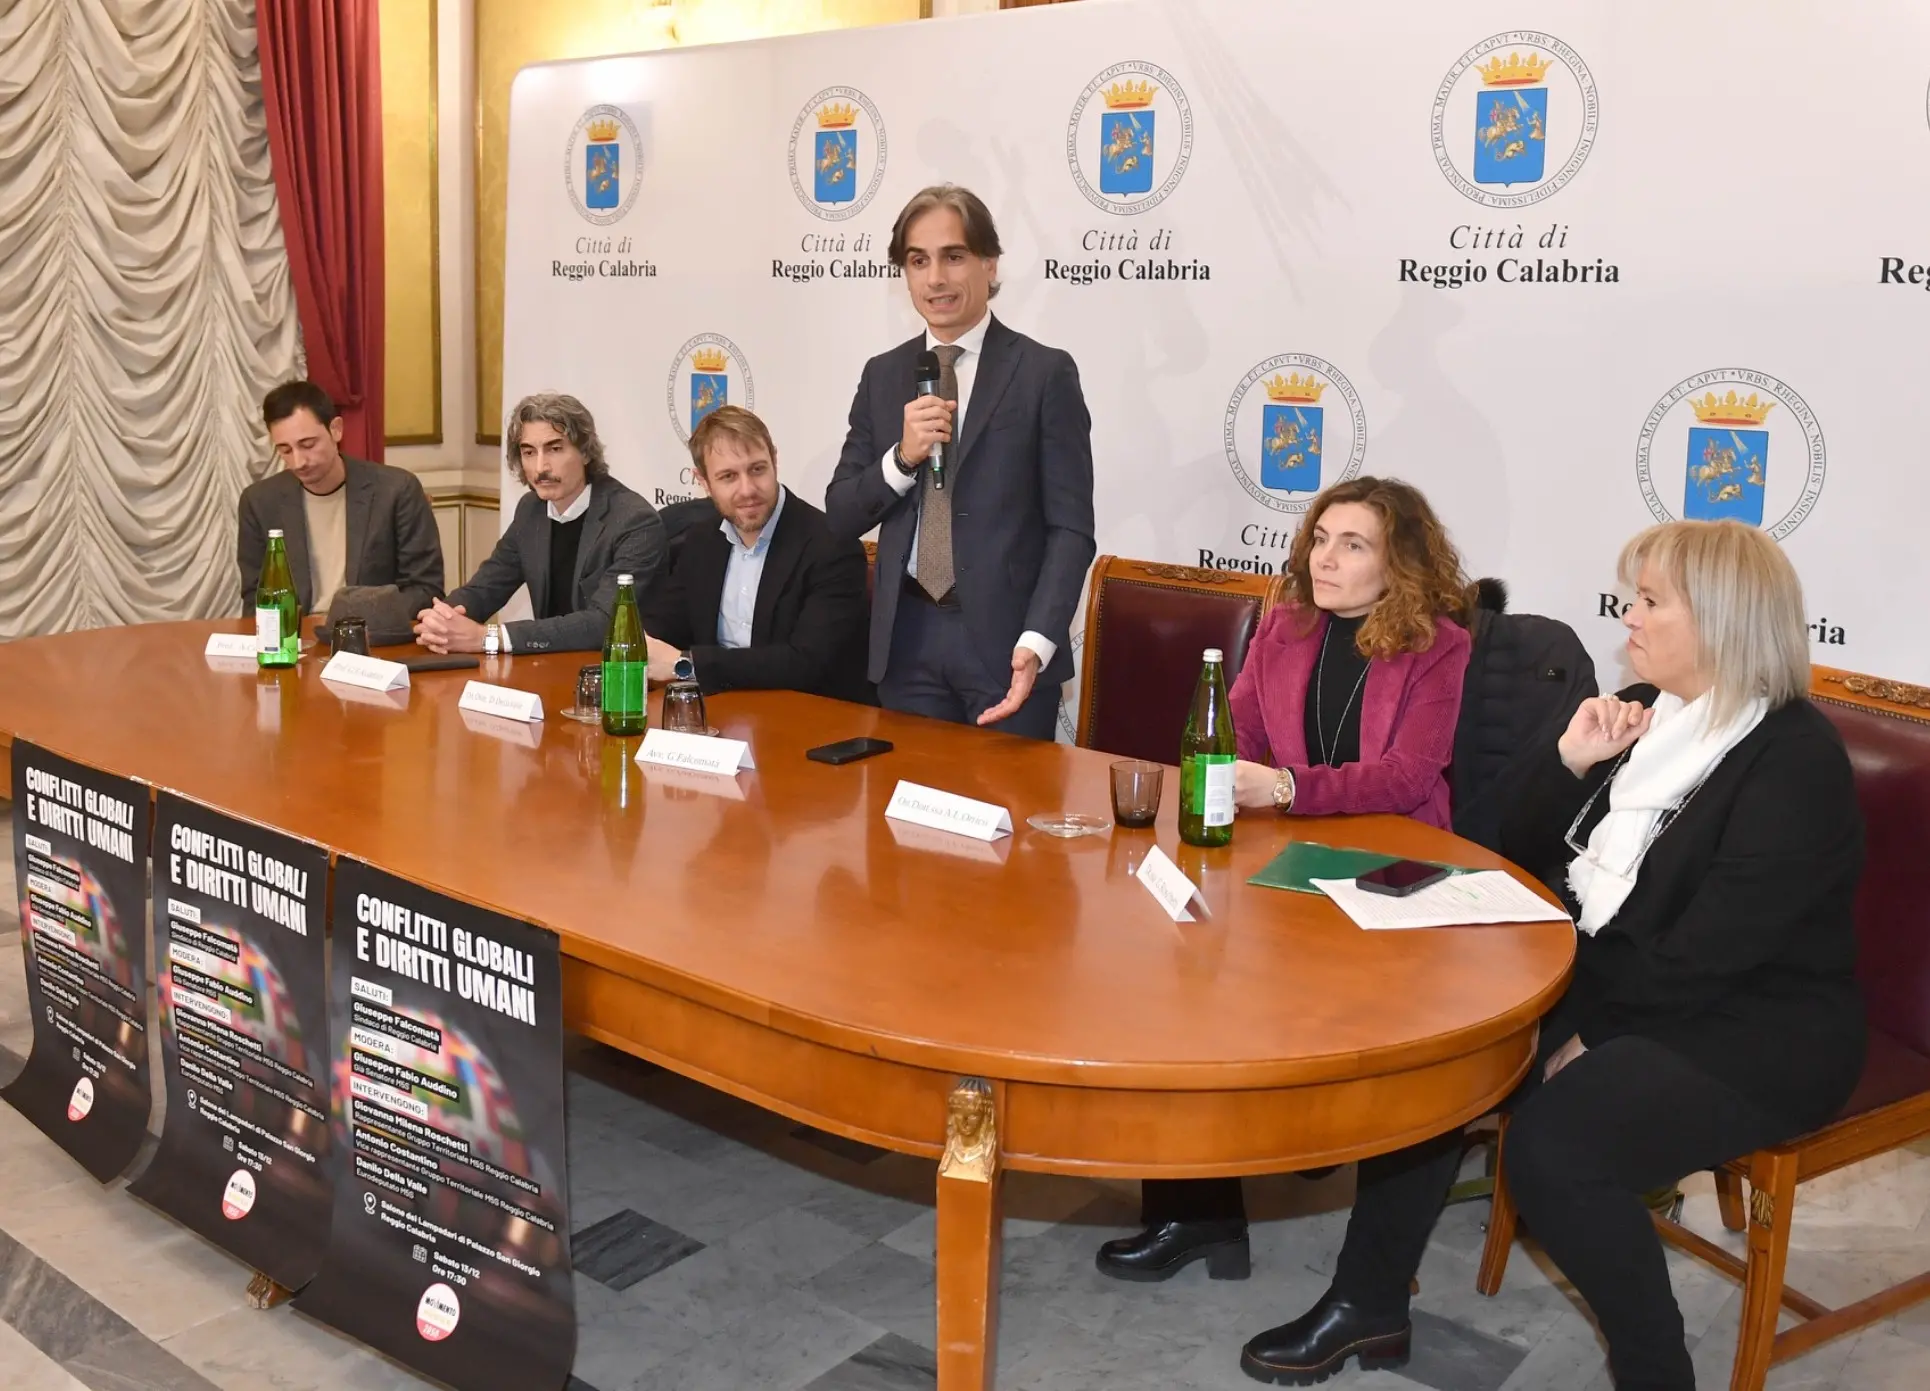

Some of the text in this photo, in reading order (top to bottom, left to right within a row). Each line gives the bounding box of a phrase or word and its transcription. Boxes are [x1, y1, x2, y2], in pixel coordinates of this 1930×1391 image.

[575, 236, 633, 255] Città di
[800, 233, 870, 253] Città di
[1082, 229, 1172, 251] Città di
[1450, 224, 1569, 249] Città di
[552, 260, 657, 282] Reggio Calabria
[772, 259, 902, 282] Reggio Calabria
[1045, 260, 1210, 285] Reggio Calabria
[1398, 258, 1620, 290] Reggio Calabria
[1241, 524, 1288, 548] Citt
[26, 766, 134, 830] CONFLITTI GLOBALI
[27, 793, 134, 863] E DIRITTI UMANI
[171, 823, 307, 899] CONFLITTI GLOBALI
[170, 853, 307, 936] E DIRITTI UMANI
[357, 893, 534, 985] CONFLITTI GLOBALI
[354, 982, 389, 1002] SALUTI:
[357, 927, 536, 1026] E DIRITTI UMANI
[354, 1002, 439, 1042] Giuseppe Falcomatà
[354, 1032, 394, 1054] MODERA:
[354, 1052, 457, 1099] Giuseppe Fabio Auddino
[353, 1081, 425, 1115] INTERVENGONO:
[354, 1101, 394, 1123] Giovanna
[356, 1129, 438, 1170] Antonio Costantino
[356, 1156, 382, 1176] Danilo
[406, 1178, 428, 1195] Valle
[381, 1212, 436, 1244] Reggio Calabria
[432, 1264, 445, 1277] Ore
[433, 1251, 480, 1279] Sabato 13/12
[467, 1238, 495, 1258] Palazzo
[496, 1251, 510, 1265] San
[512, 1258, 540, 1278] Giorgio
